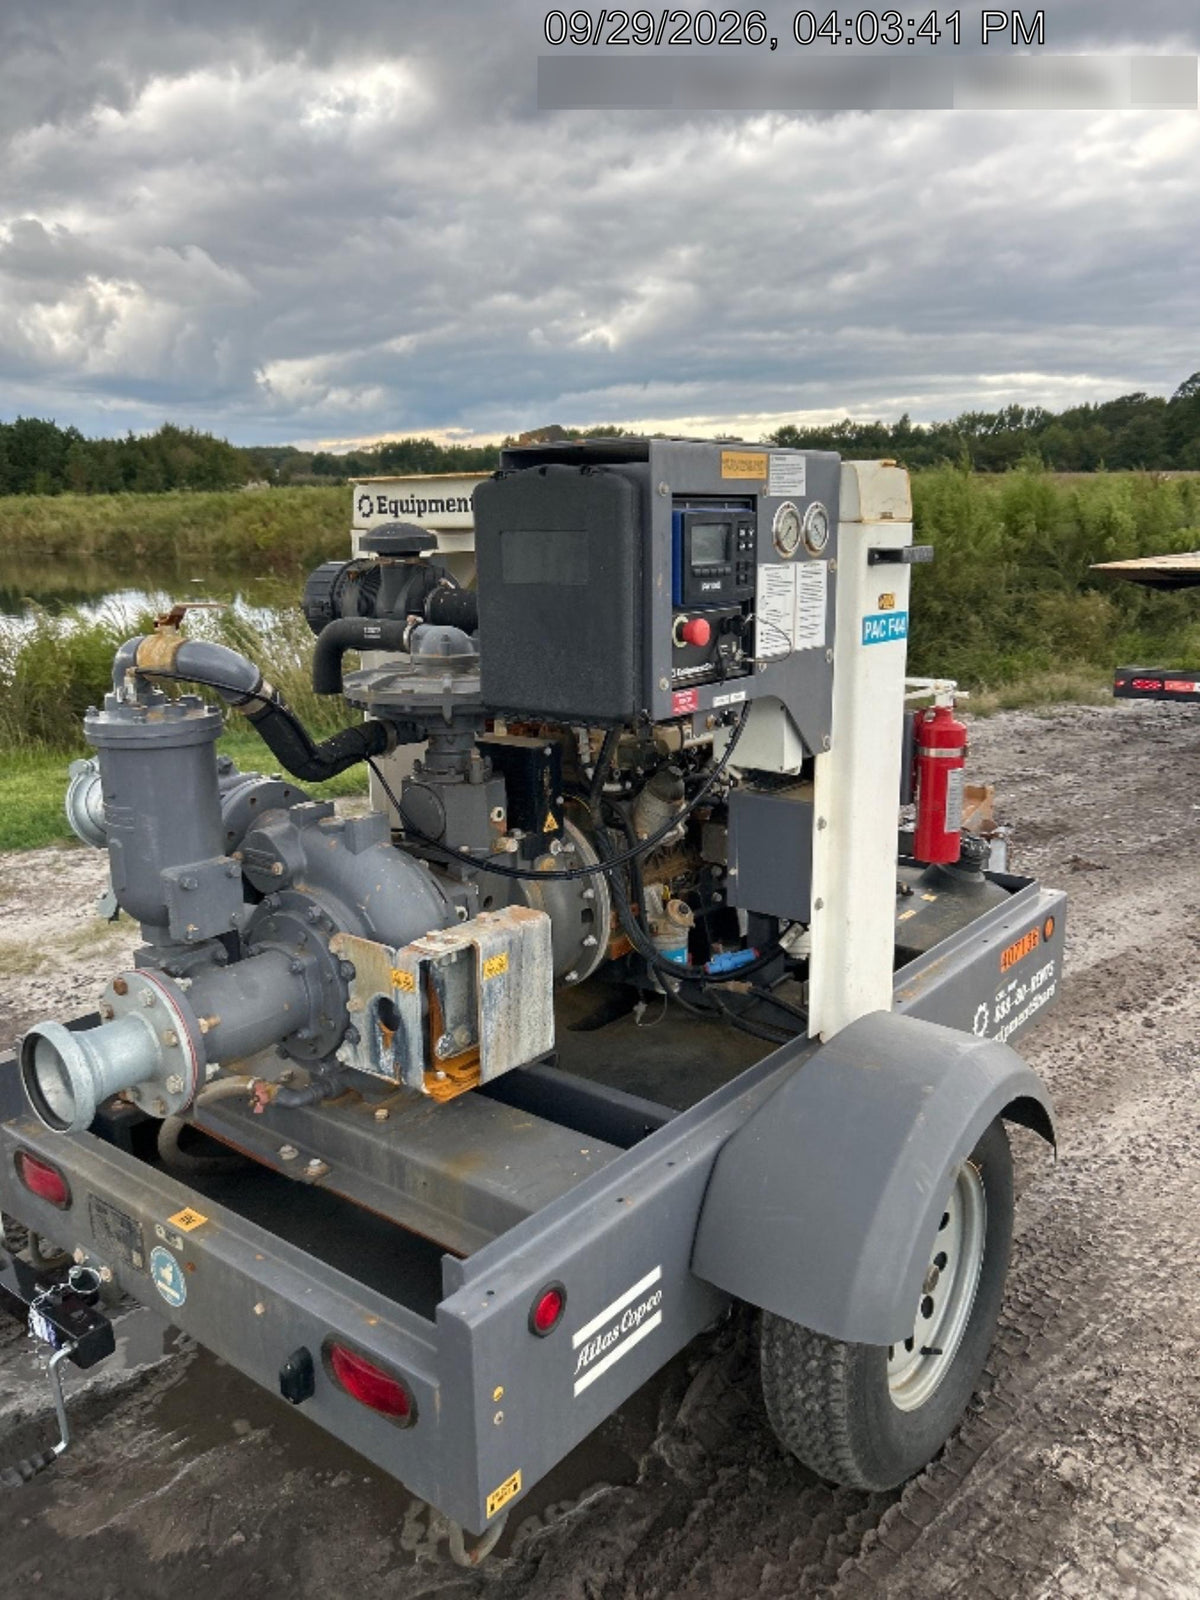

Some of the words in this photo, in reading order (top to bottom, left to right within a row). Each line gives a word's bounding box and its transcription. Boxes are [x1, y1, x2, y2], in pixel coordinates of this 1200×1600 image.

[864, 619, 887, 641] PAC
[573, 1324, 620, 1375] Atlas
[620, 1289, 663, 1334] Copco
